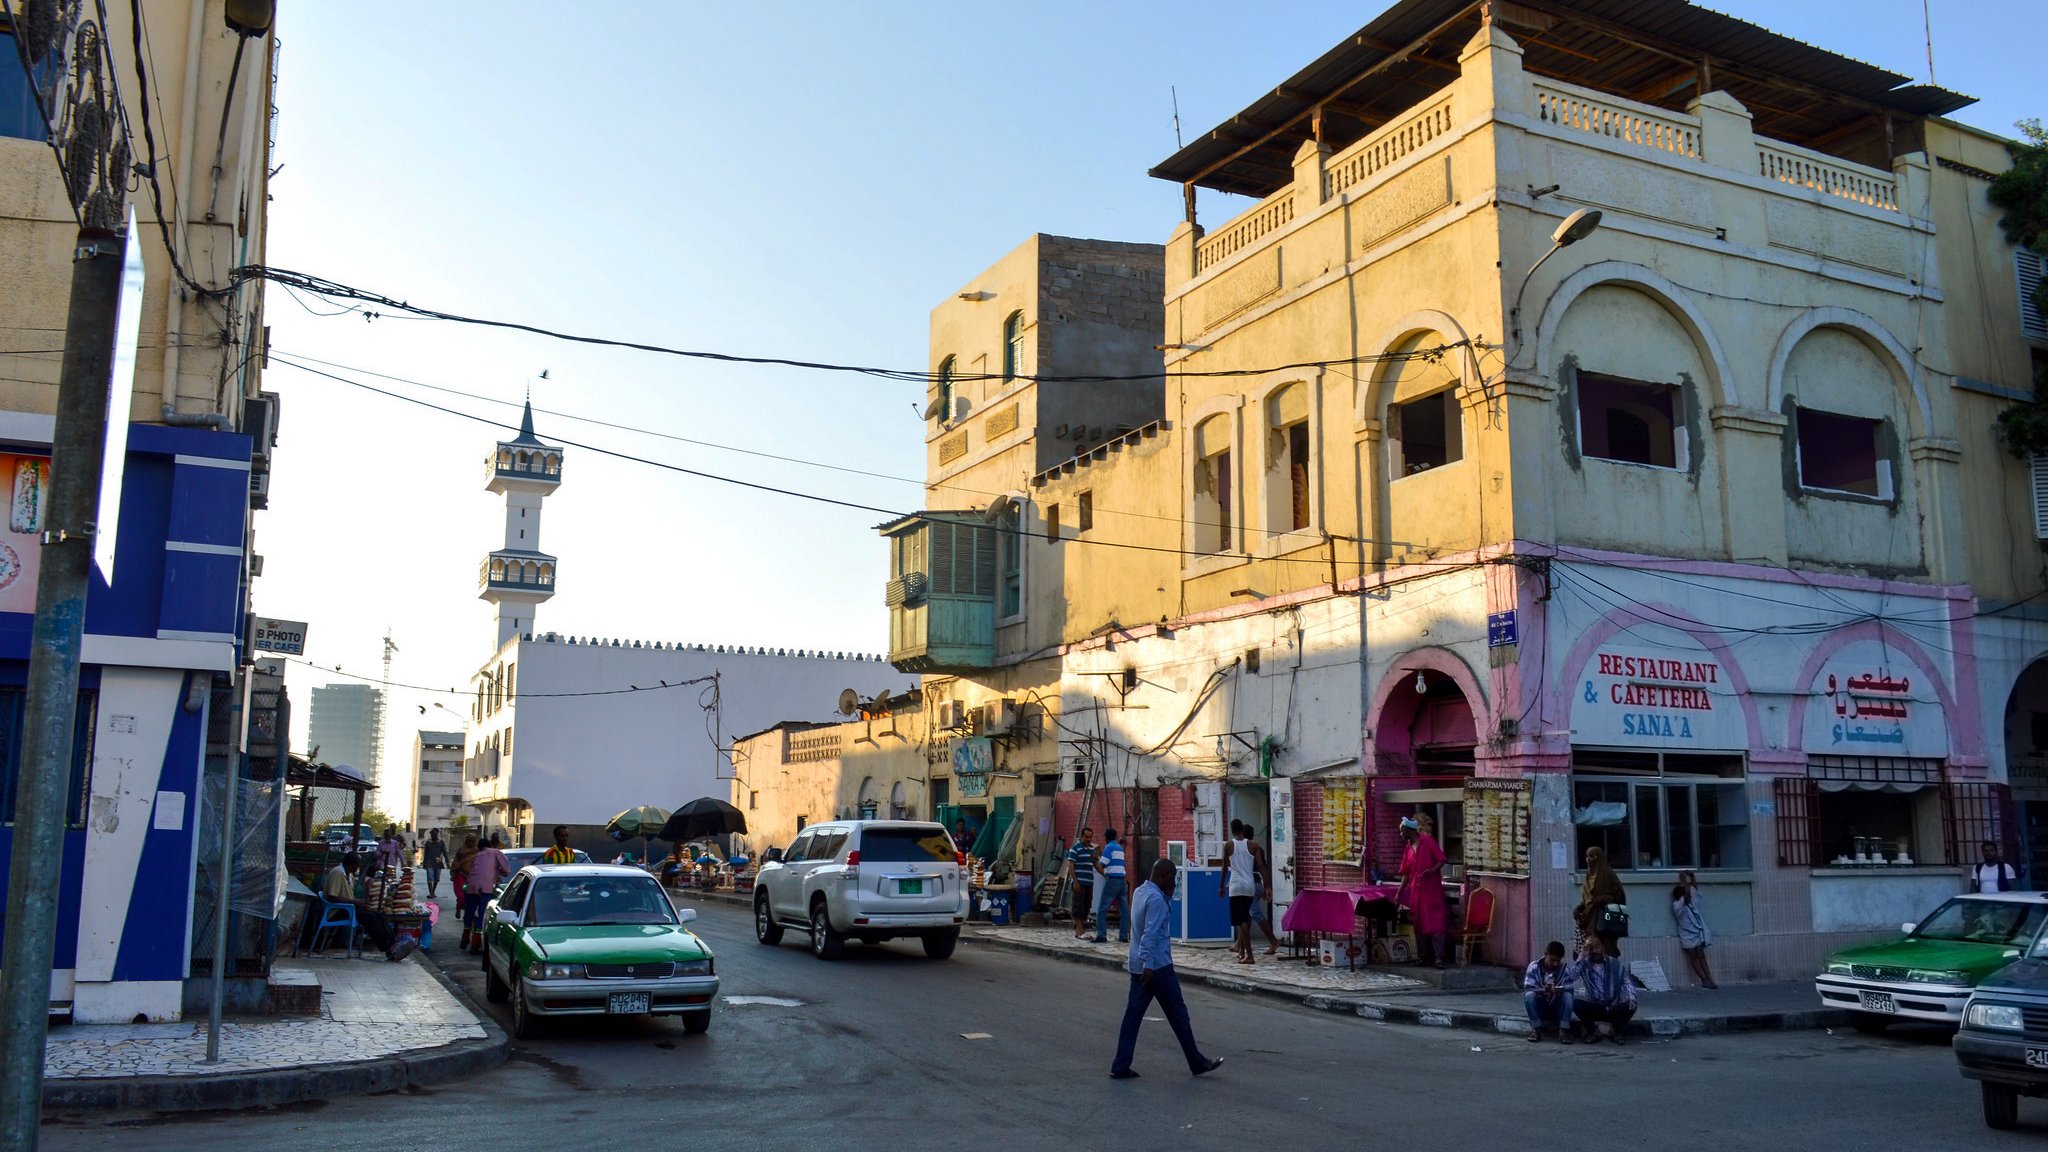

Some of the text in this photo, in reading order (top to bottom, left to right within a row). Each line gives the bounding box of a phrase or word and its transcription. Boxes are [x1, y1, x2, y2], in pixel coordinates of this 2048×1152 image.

[266, 630, 301, 642] PHOTO
[274, 643, 300, 652] CAFE
[1598, 653, 1717, 683] RESTAURANT
[1584, 680, 1712, 710] & CAFETERIA
[1623, 713, 1692, 738] SANA'A
